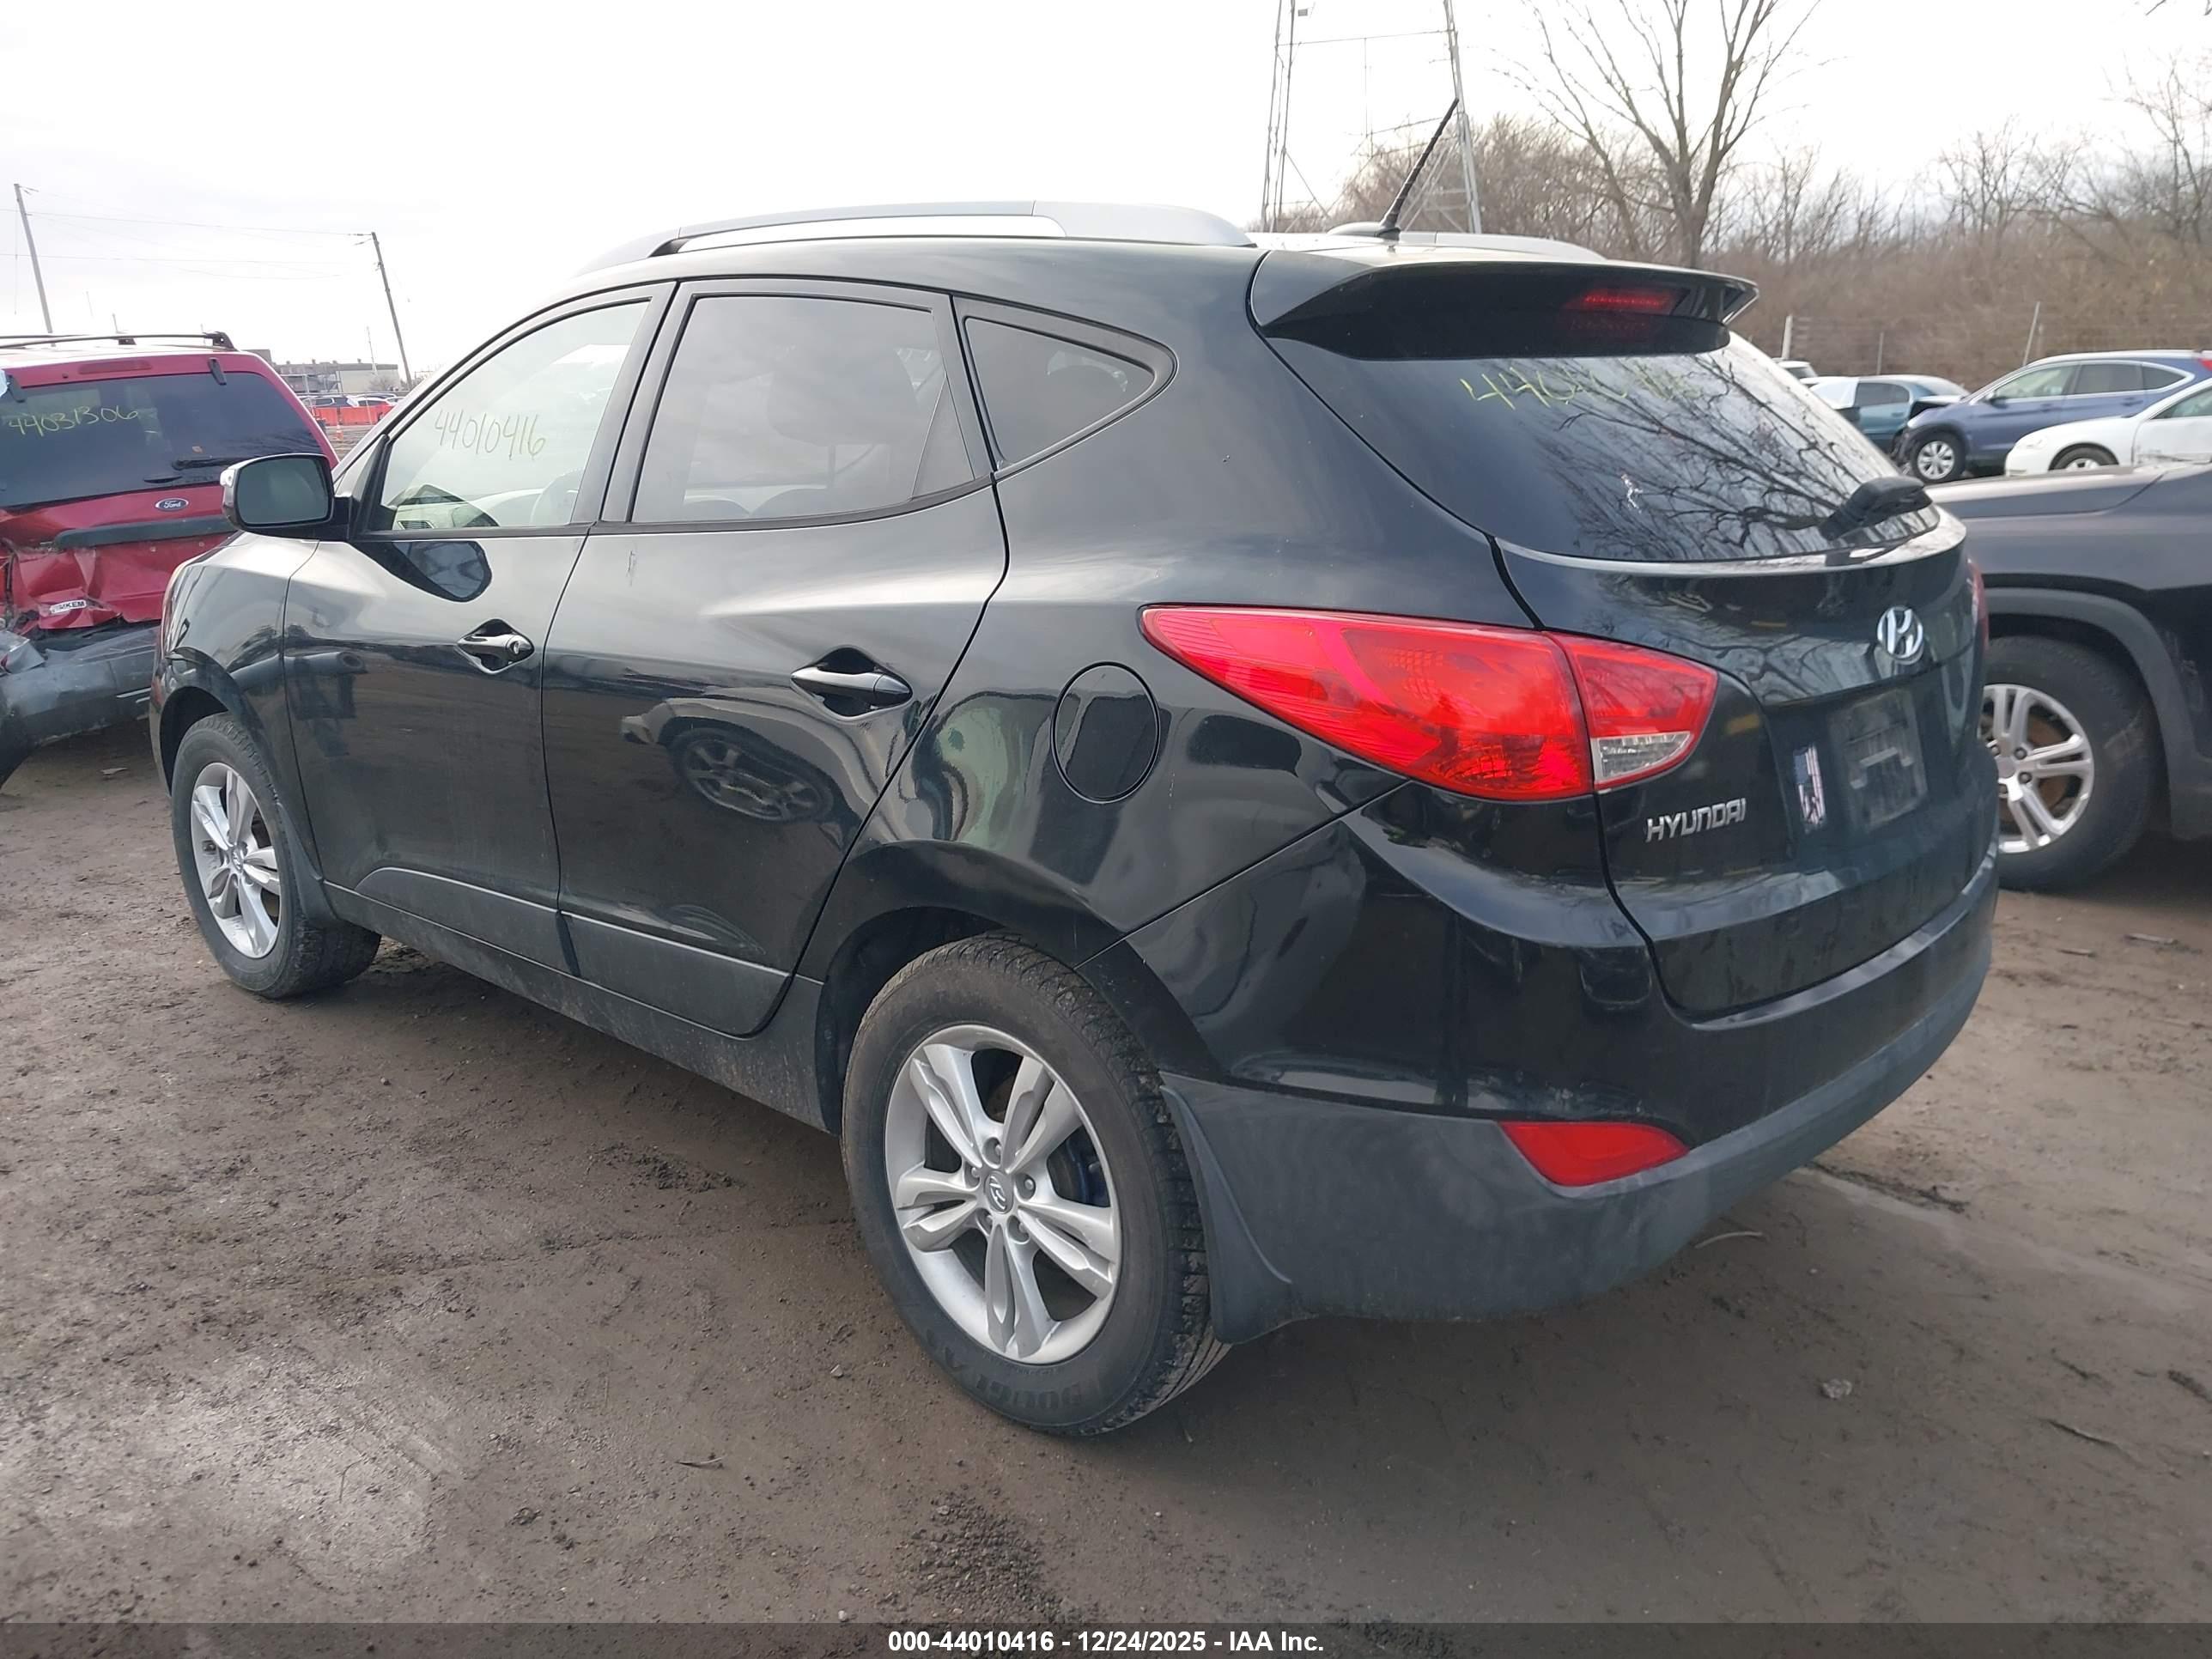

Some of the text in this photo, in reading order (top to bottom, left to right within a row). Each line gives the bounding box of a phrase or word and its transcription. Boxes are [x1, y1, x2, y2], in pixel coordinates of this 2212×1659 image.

[9, 404, 138, 436] 44031306
[434, 409, 546, 460] 44010416
[1645, 797, 1747, 842] HYUNDAI
